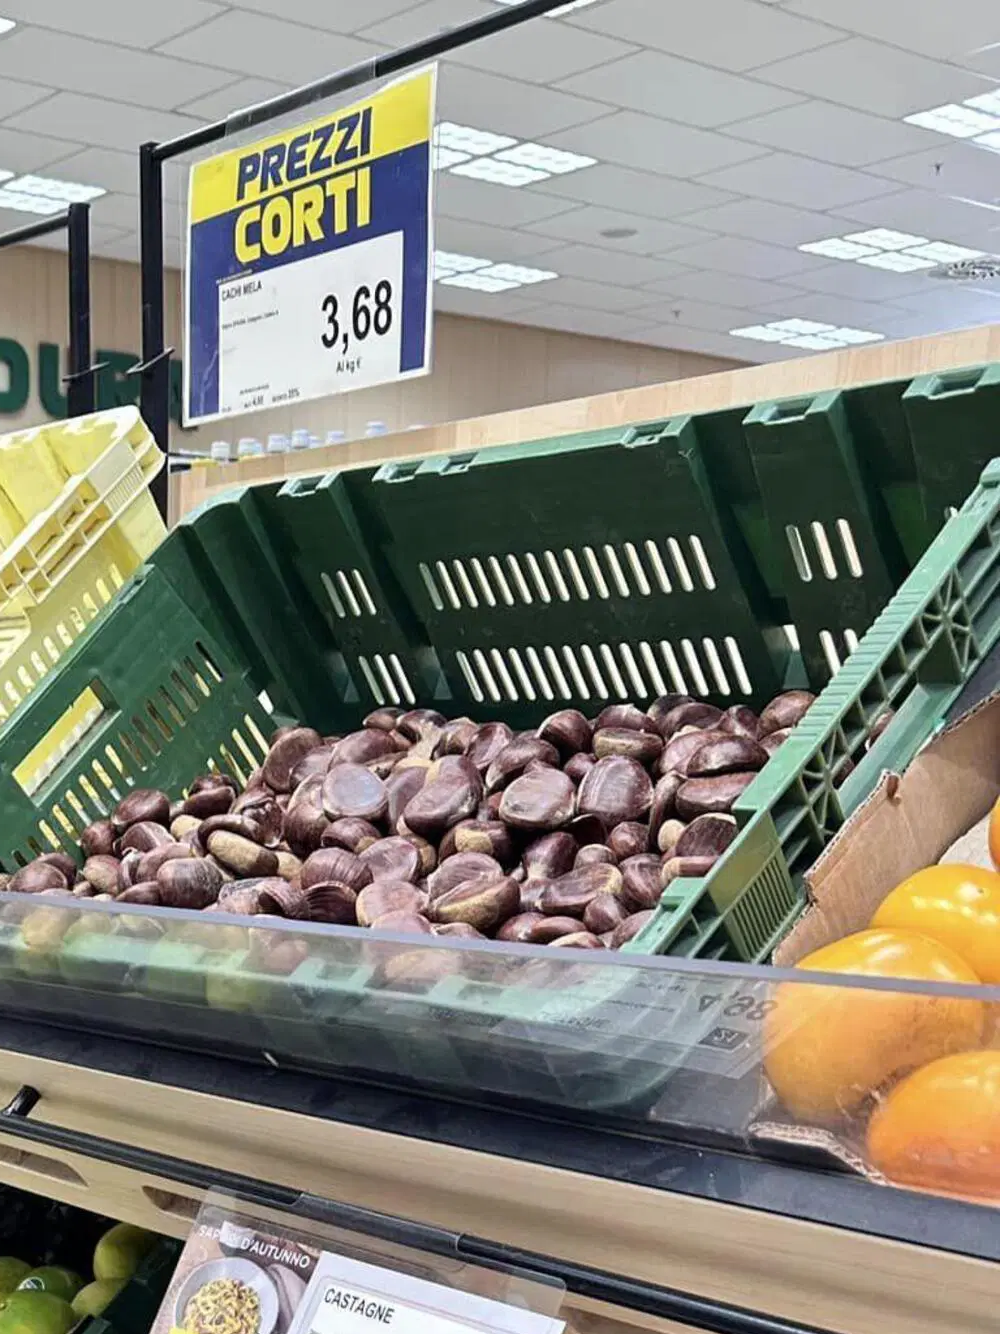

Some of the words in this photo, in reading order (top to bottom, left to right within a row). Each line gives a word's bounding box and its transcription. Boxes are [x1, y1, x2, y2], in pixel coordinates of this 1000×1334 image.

[236, 106, 373, 202] PREZZI
[234, 166, 371, 263] CORTI
[321, 279, 392, 355] 3,68
[241, 1238, 311, 1269] D'AUTUNNO
[324, 1287, 395, 1325] CASTAGNE
